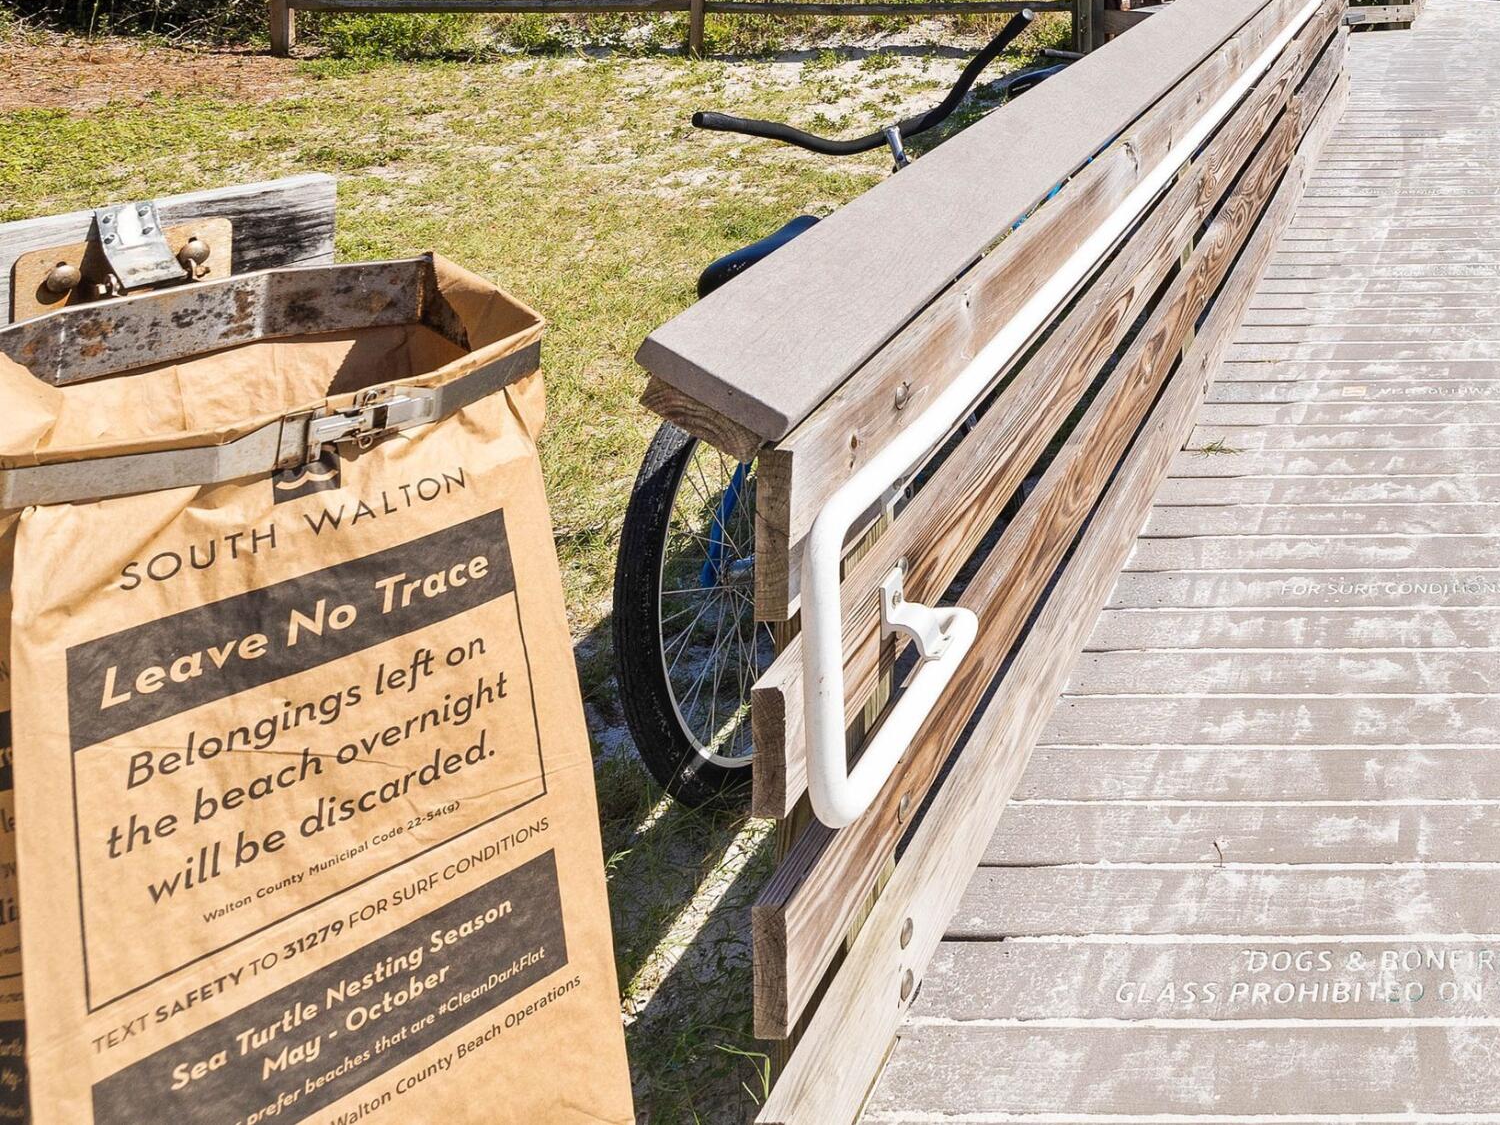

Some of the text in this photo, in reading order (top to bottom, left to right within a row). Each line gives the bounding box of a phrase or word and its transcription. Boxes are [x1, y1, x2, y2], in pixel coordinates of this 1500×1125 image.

[119, 467, 466, 592] SOUTH WALTON
[1281, 583, 1321, 596] FOR
[100, 555, 490, 711] Leave No Trace
[106, 671, 509, 860] the beach overnight
[127, 637, 487, 791] Belongings left on
[147, 728, 497, 906] will be discarded.
[202, 800, 461, 924] Walton County Municipal Code 22-54(g)
[92, 817, 550, 1055] TEXT SAFETY TO 31279 FOR SURF CONDITIONS
[170, 898, 514, 1092] Sea Turtle Nesting Season
[1115, 980, 1217, 1004] GLASS
[1228, 980, 1425, 1004] PROHIBITED
[1439, 981, 1483, 1003] ON
[1246, 949, 1333, 973] DOGS
[1346, 949, 1365, 971] &
[246, 945, 546, 1125] prefer beaches that are #CleanDarkFlat
[261, 1036, 321, 1083] May
[345, 963, 452, 1032] October
[330, 972, 583, 1125] Walton County Beach Operations
